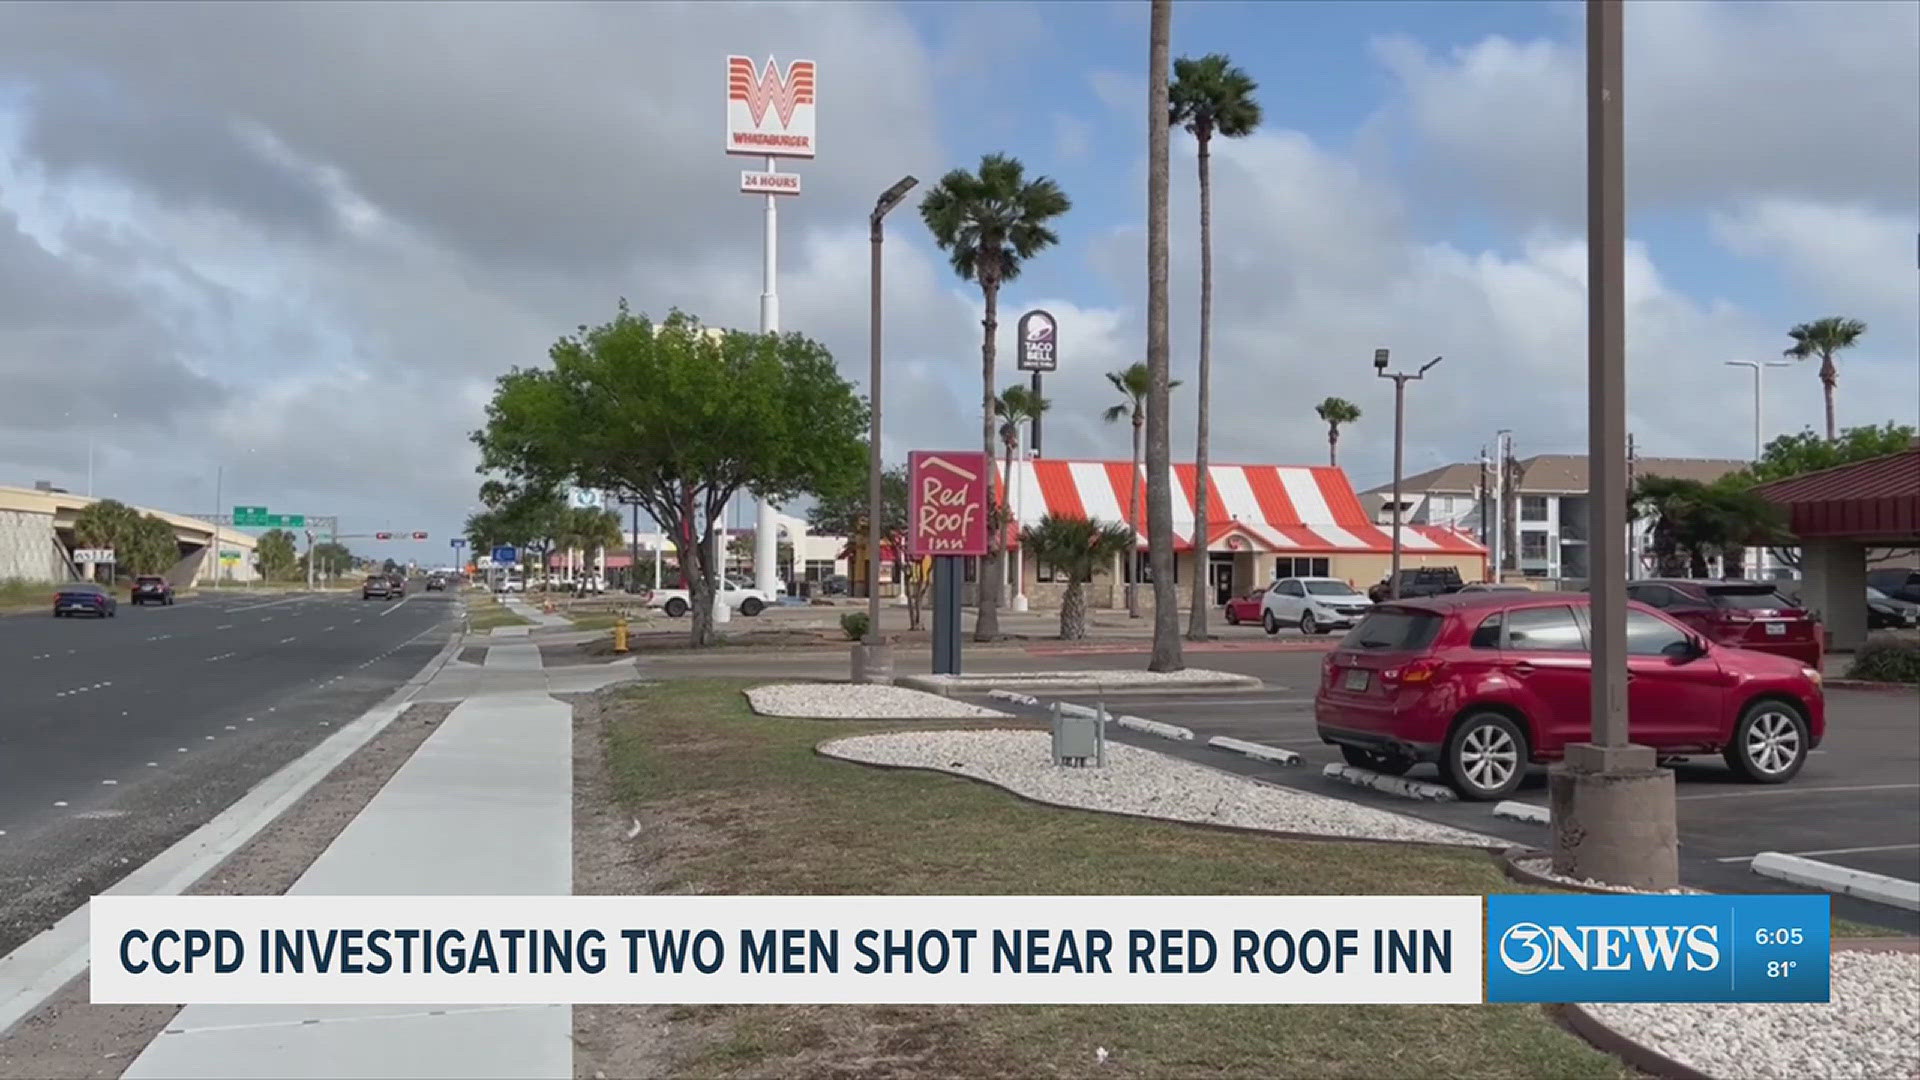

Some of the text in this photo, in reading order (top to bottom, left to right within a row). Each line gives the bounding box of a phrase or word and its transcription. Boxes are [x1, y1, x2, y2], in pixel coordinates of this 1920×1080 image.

[733, 132, 810, 147] WHATABURGER
[744, 175, 798, 188] 24 HOURS
[1024, 341, 1053, 351] TACO
[1026, 351, 1052, 361] BELL
[923, 477, 969, 507] Red
[919, 503, 980, 538] Roof
